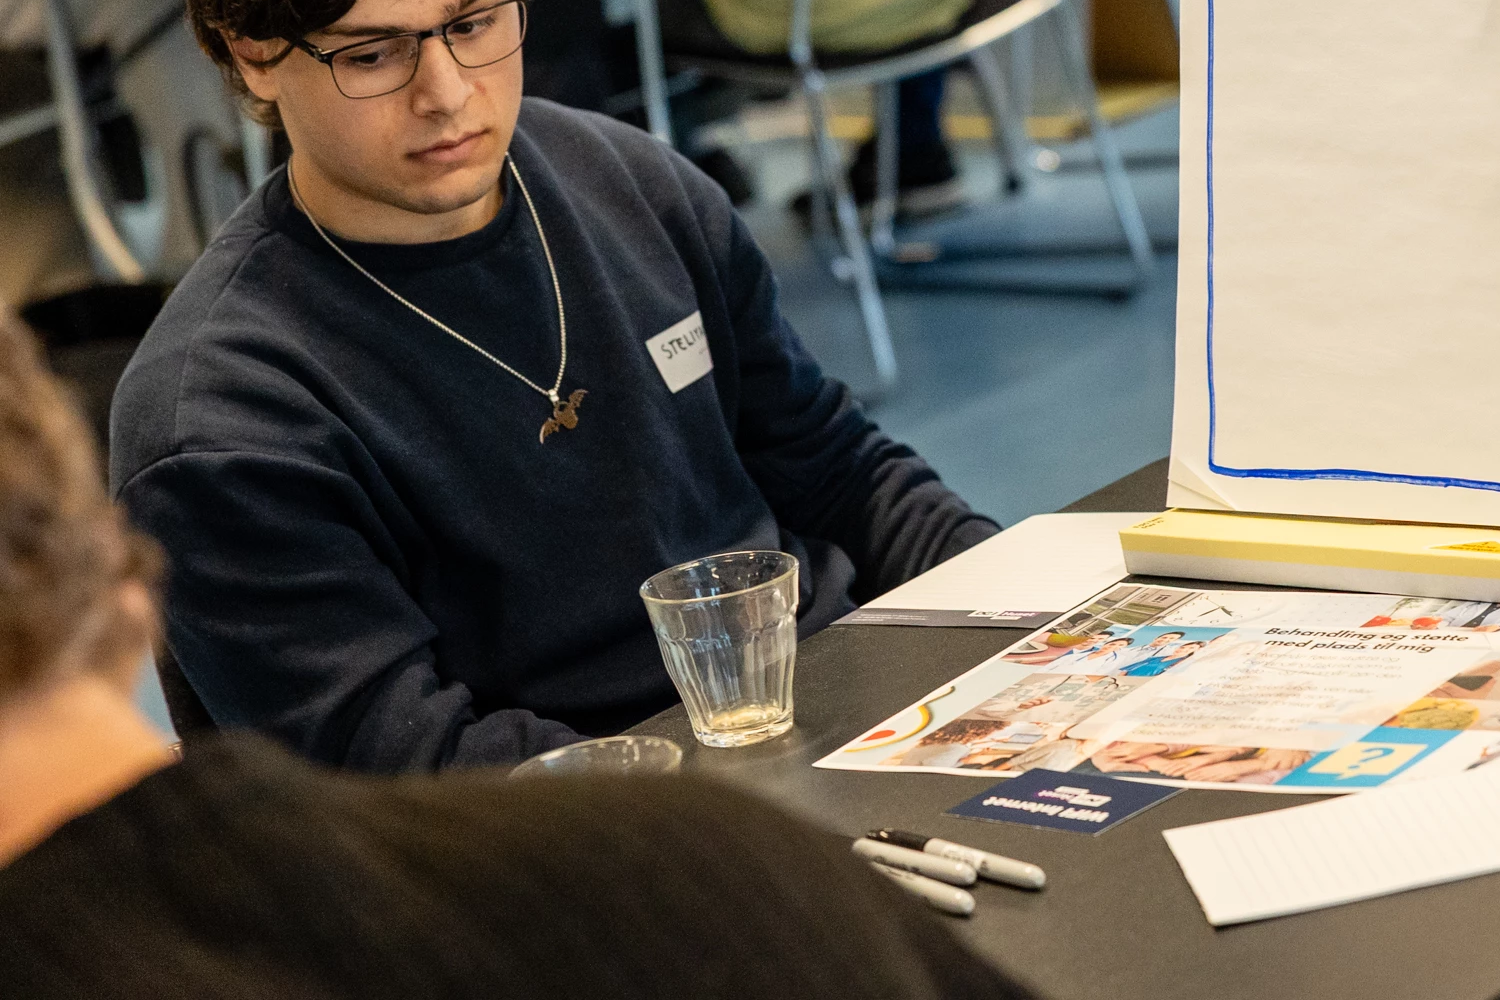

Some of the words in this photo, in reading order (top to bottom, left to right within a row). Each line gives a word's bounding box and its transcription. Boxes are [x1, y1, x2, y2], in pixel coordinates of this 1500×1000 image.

[1264, 627, 1377, 641] Behandling
[1380, 633, 1408, 642] og
[1411, 632, 1469, 642] støtte
[1264, 638, 1313, 649] med
[1310, 640, 1369, 652] plads
[1372, 641, 1397, 651] til
[1397, 643, 1436, 654] mig
